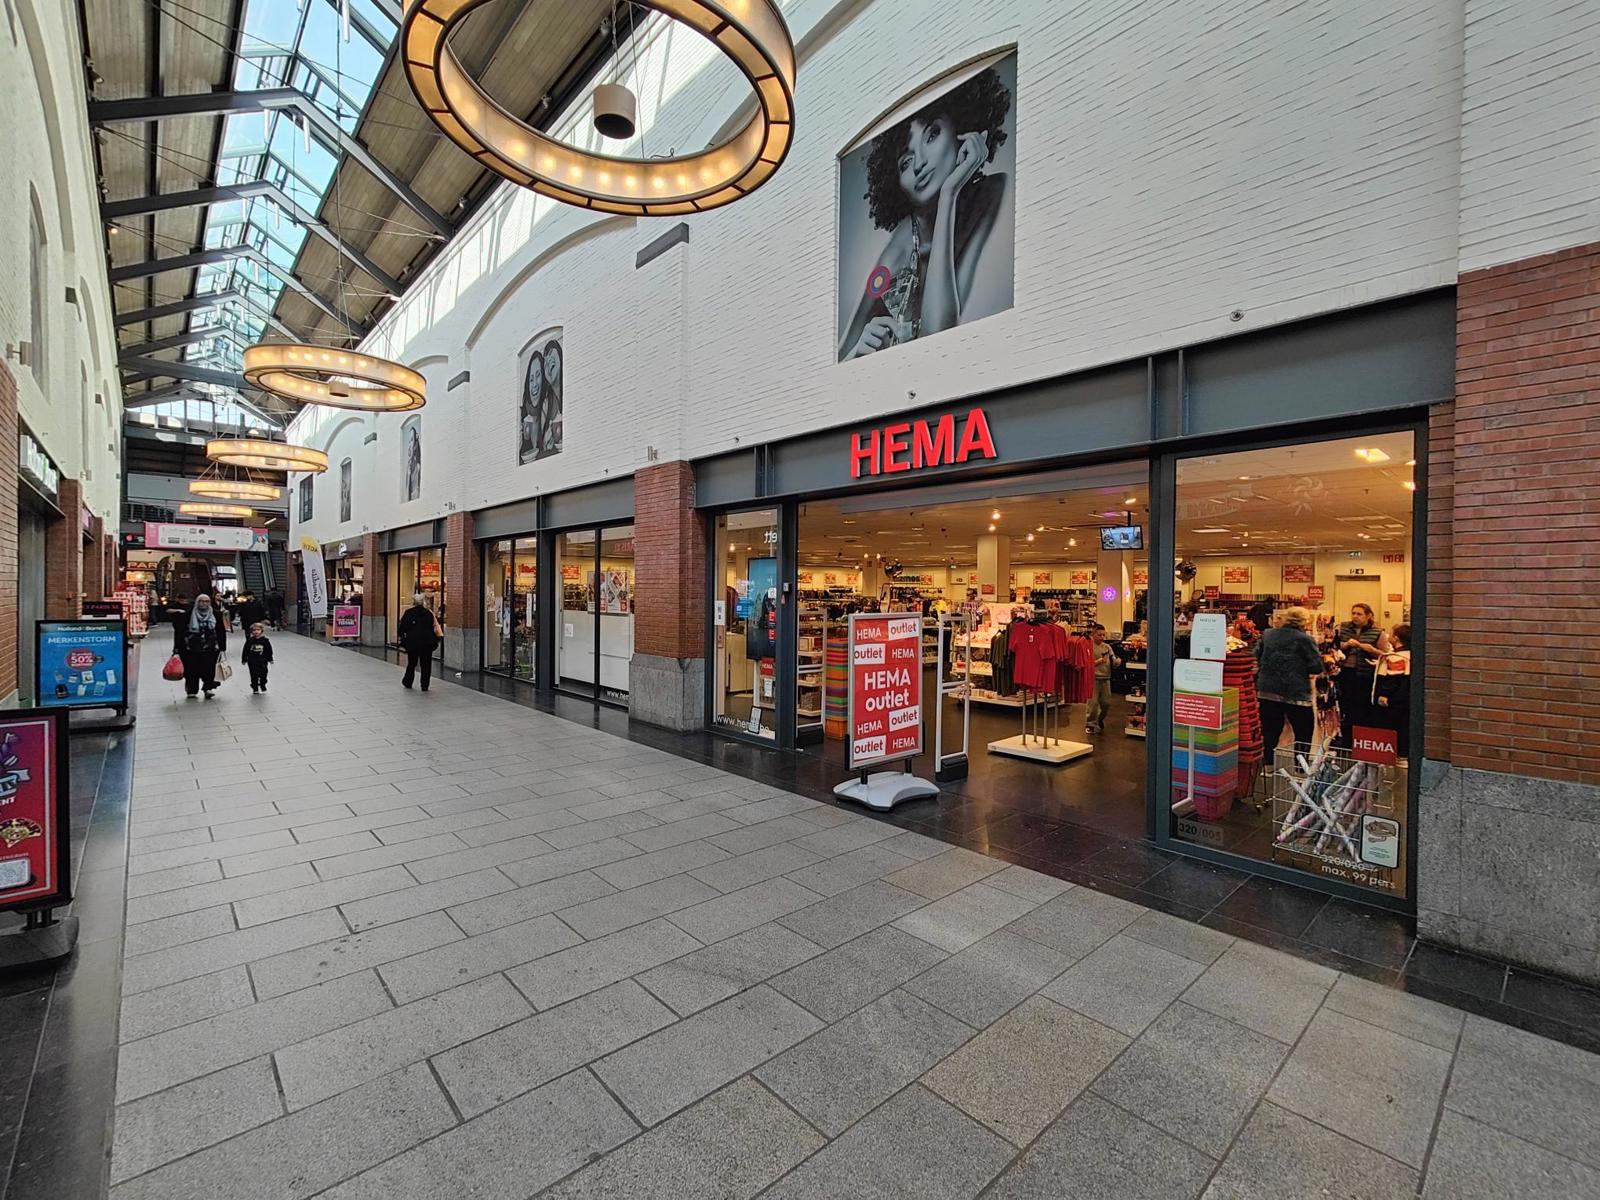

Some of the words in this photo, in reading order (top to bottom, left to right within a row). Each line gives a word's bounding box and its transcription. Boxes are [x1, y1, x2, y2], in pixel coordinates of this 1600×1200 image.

[850, 407, 997, 479] HEMA
[856, 626, 882, 640] HEMA
[890, 621, 917, 636] outlet
[47, 636, 116, 644] MERKENSTORM
[71, 655, 94, 663] 50%
[854, 647, 883, 659] outlet
[891, 648, 915, 659] HEMA
[864, 669, 911, 691] HEMA
[865, 688, 909, 712] outlet
[857, 719, 883, 735] HEMA
[891, 710, 918, 726] outlet
[854, 737, 883, 754] outlet
[892, 737, 916, 749] HEMA
[1353, 738, 1395, 753] HEMA
[1321, 865, 1350, 879] max.
[1352, 871, 1367, 882] 99
